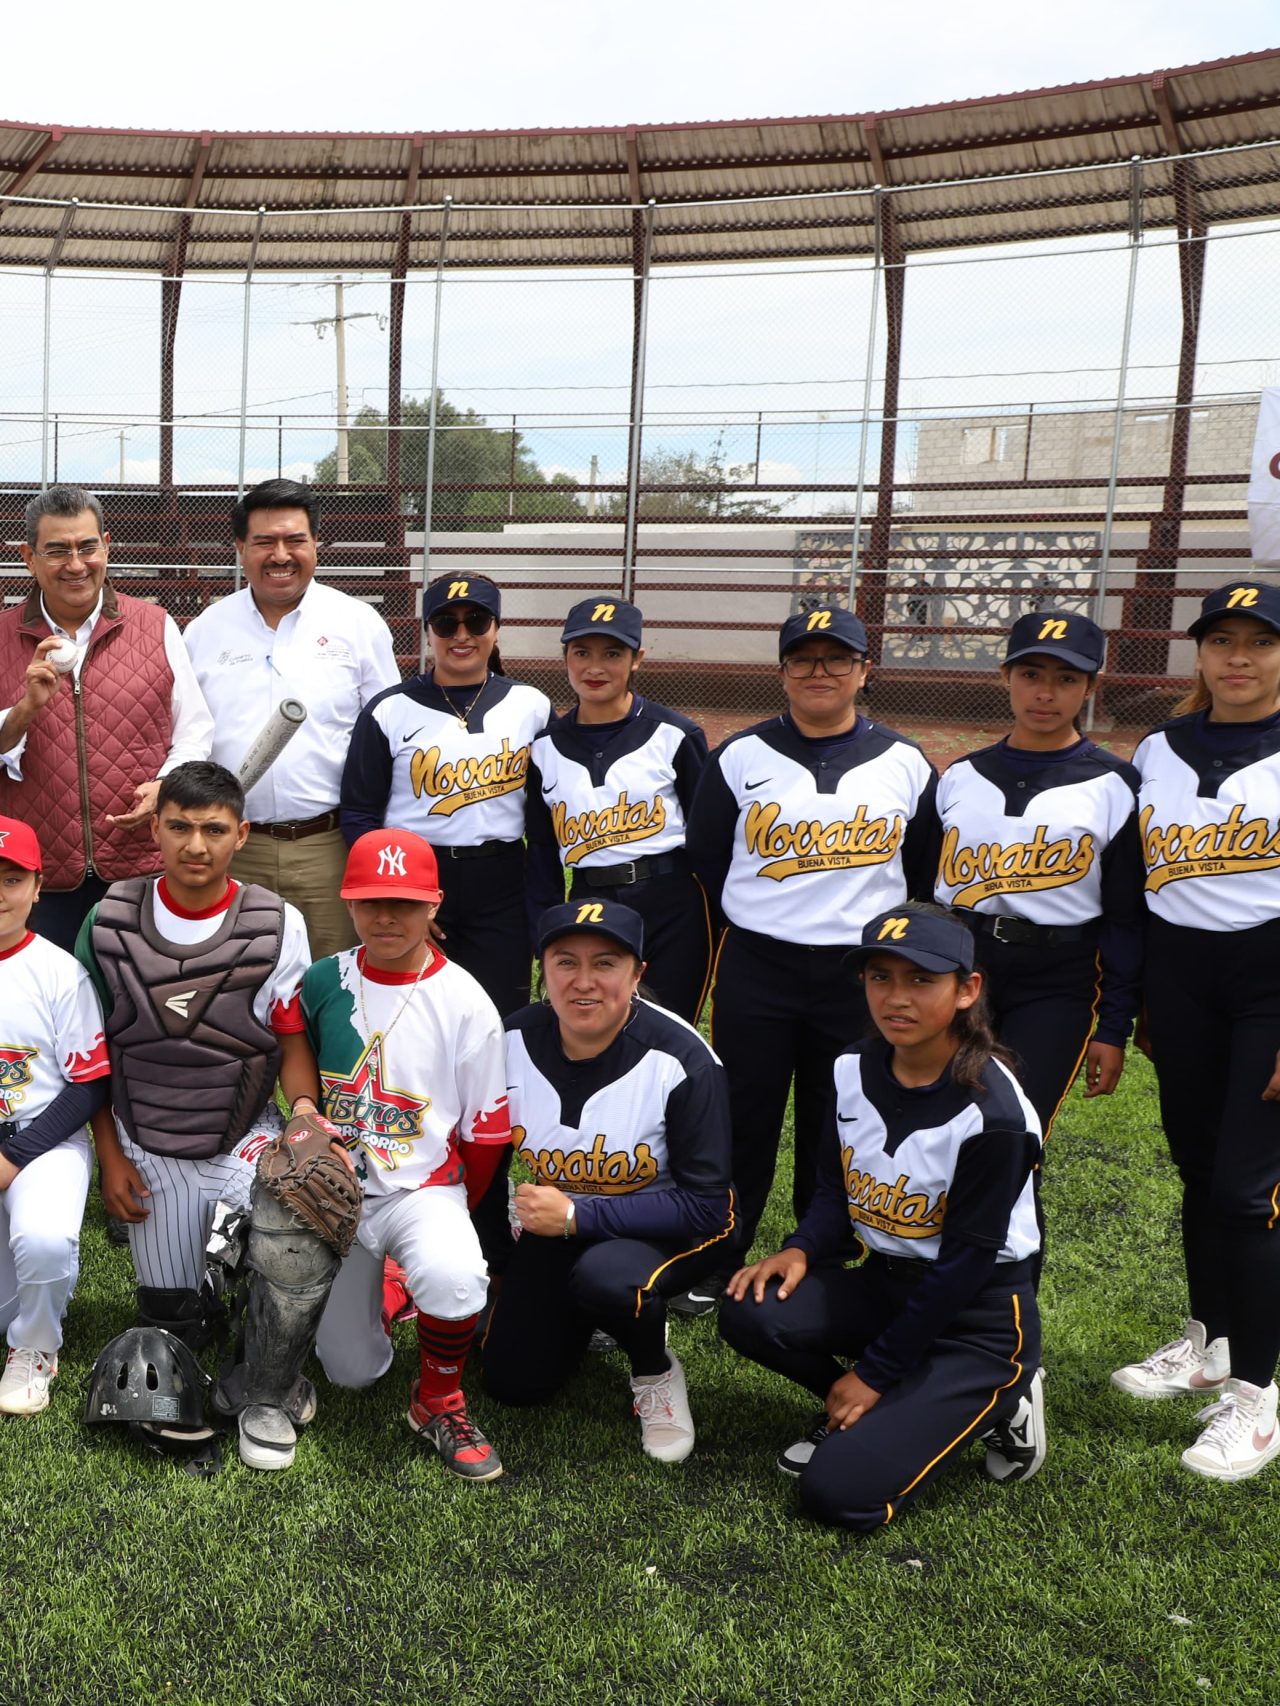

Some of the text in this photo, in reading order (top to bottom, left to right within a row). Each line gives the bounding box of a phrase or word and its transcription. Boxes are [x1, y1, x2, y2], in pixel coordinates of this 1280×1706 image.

[463, 785, 506, 802] BUENA VISTA
[745, 801, 902, 858] Novatas
[585, 834, 631, 852] BUENA VISTA
[376, 843, 408, 876] NY
[797, 857, 851, 869] BUENA VISTA
[1168, 862, 1227, 877] BUENA VISTA
[984, 879, 1033, 892] BUENA VISTA
[359, 1130, 410, 1154] GORDO
